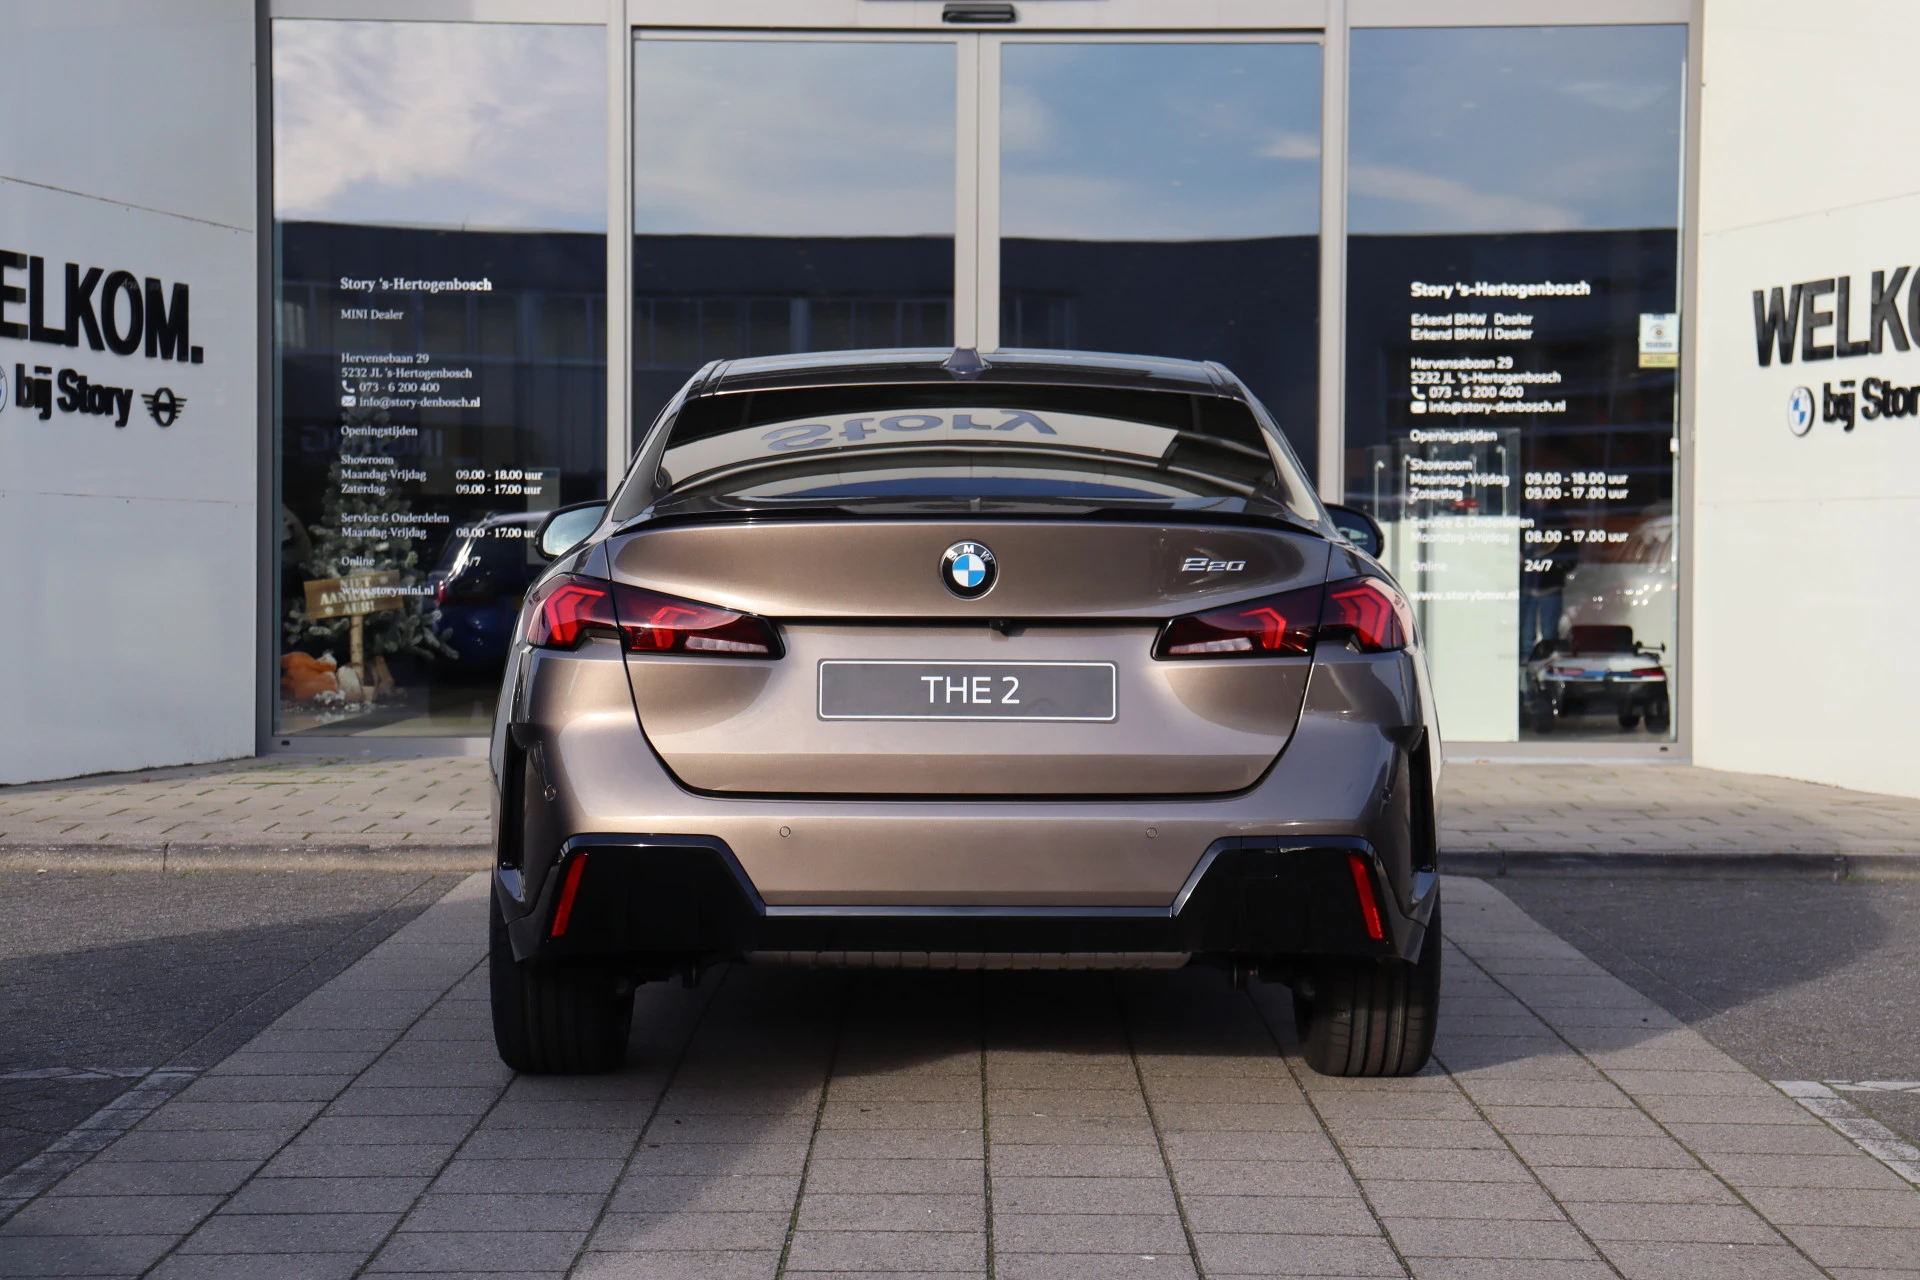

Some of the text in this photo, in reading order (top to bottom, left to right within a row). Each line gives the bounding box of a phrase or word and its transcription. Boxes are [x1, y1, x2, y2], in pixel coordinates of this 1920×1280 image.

[340, 277, 376, 293] Story
[1410, 281, 1454, 299] Story
[0, 249, 204, 364] ELKOM.
[341, 309, 404, 320] MINI Dealer
[1410, 313, 1534, 326] Erkend BMW Dealer
[1410, 327, 1453, 340] Erkend
[1454, 327, 1487, 340] BMW
[1494, 327, 1534, 340] Dealer
[341, 353, 430, 363] Hervensebaan 29
[1410, 356, 1514, 370] Hervensebaan 29
[341, 367, 367, 378] 5232
[369, 367, 383, 378] JL
[1410, 371, 1441, 384] 5232
[1441, 371, 1456, 385] JL
[359, 382, 379, 392] 073
[388, 382, 396, 392] 6
[397, 382, 418, 392] 200
[419, 382, 440, 392] 400
[1428, 385, 1452, 398] 073
[1461, 385, 1471, 398] 6
[1472, 385, 1497, 398] 200
[1498, 385, 1524, 398] 400
[15, 363, 134, 427] bij Story
[360, 396, 481, 409] info@story-denbosch.nl
[1822, 377, 1920, 432] bij Stor
[341, 425, 418, 439] Openingstijden
[1409, 428, 1498, 444] Openingstijden
[341, 455, 394, 465] Showroom
[1409, 458, 1473, 471] Showroom
[341, 469, 427, 482] Maandag-Vrijdag
[455, 469, 485, 480] 09.00
[494, 469, 523, 480] 18.00
[524, 471, 543, 480] uur
[1409, 472, 1510, 487] Maandag-Vrijdag
[1524, 472, 1562, 485] 09.00
[1571, 472, 1606, 485] 18.00
[1607, 474, 1629, 485] uur
[341, 484, 386, 496] Zaterdag
[455, 484, 485, 494] 09.00
[494, 484, 522, 494] 17.00
[523, 486, 542, 495] uur
[1409, 487, 1463, 502] Zaterdag
[1524, 487, 1562, 499] 09.00
[1607, 489, 1629, 499] uur
[341, 512, 450, 524] Service & Onderdelen
[341, 528, 427, 540] Maandag-Vrijdag
[455, 527, 485, 538] 08.00
[494, 527, 522, 538] 17.00
[523, 530, 536, 538] uu
[1524, 530, 1562, 543] 08.00
[1607, 532, 1629, 542] uur
[341, 556, 375, 567] Online
[1182, 558, 1246, 572] 220
[1524, 559, 1553, 572] 24/7
[341, 585, 435, 598] www.storymini.nl
[921, 676, 1020, 704] THE 2
